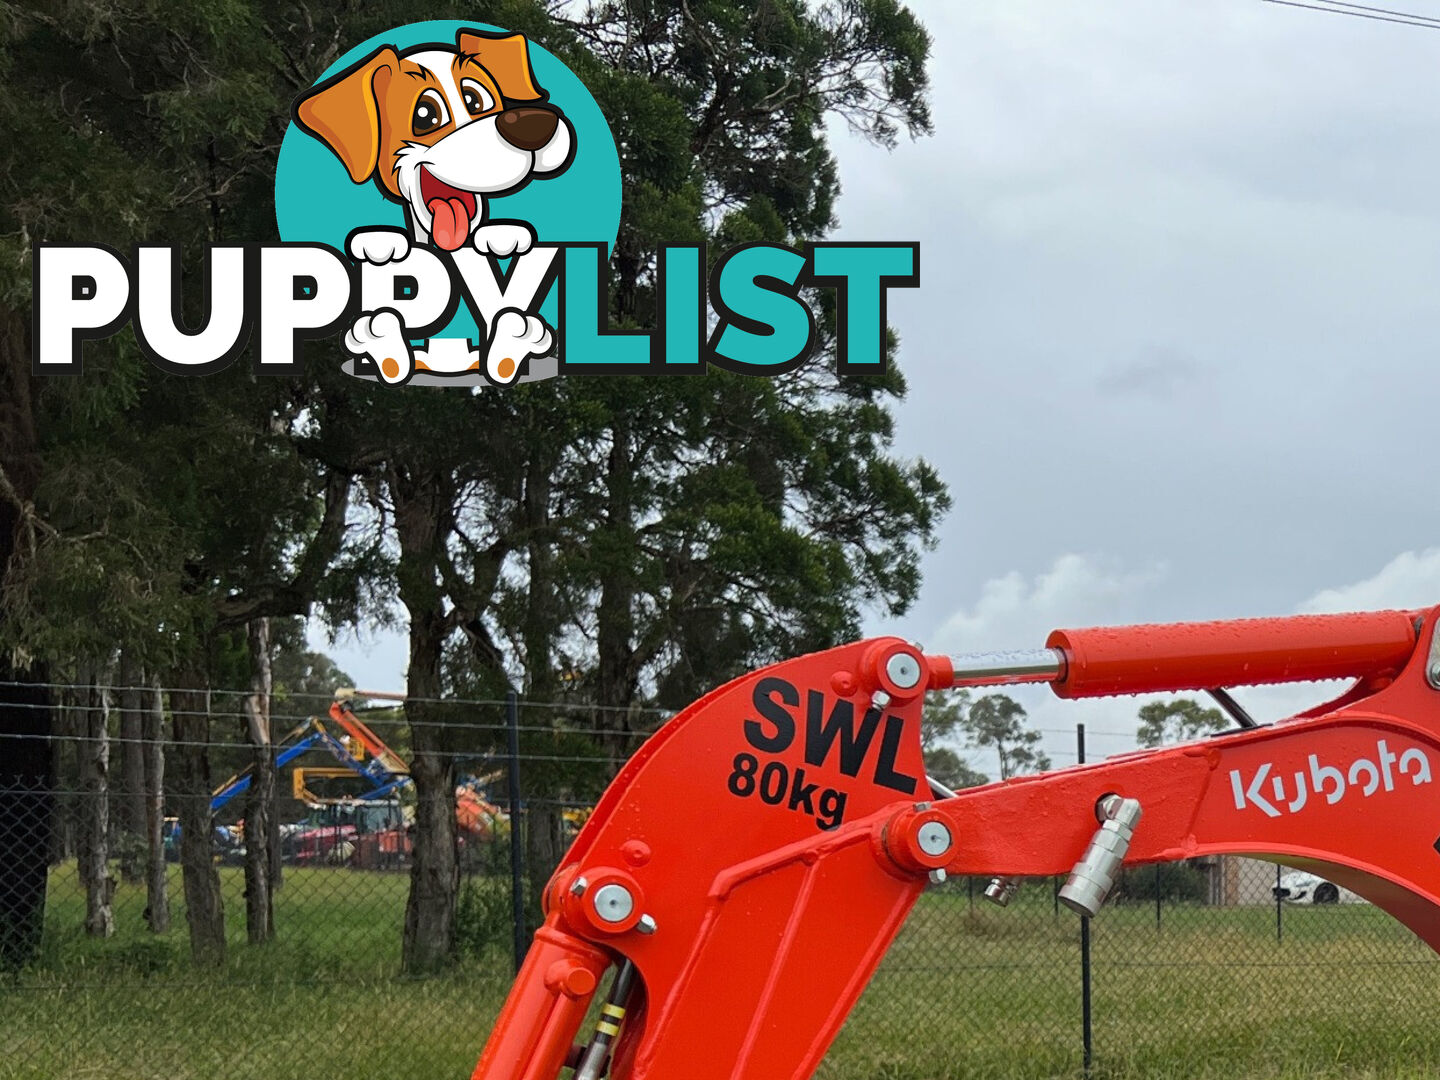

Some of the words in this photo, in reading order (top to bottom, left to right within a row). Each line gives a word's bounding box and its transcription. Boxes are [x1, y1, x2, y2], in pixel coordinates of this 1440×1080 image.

[744, 677, 917, 795] SWL
[728, 752, 848, 831] 80kg
[1229, 739, 1432, 818] Kubota
